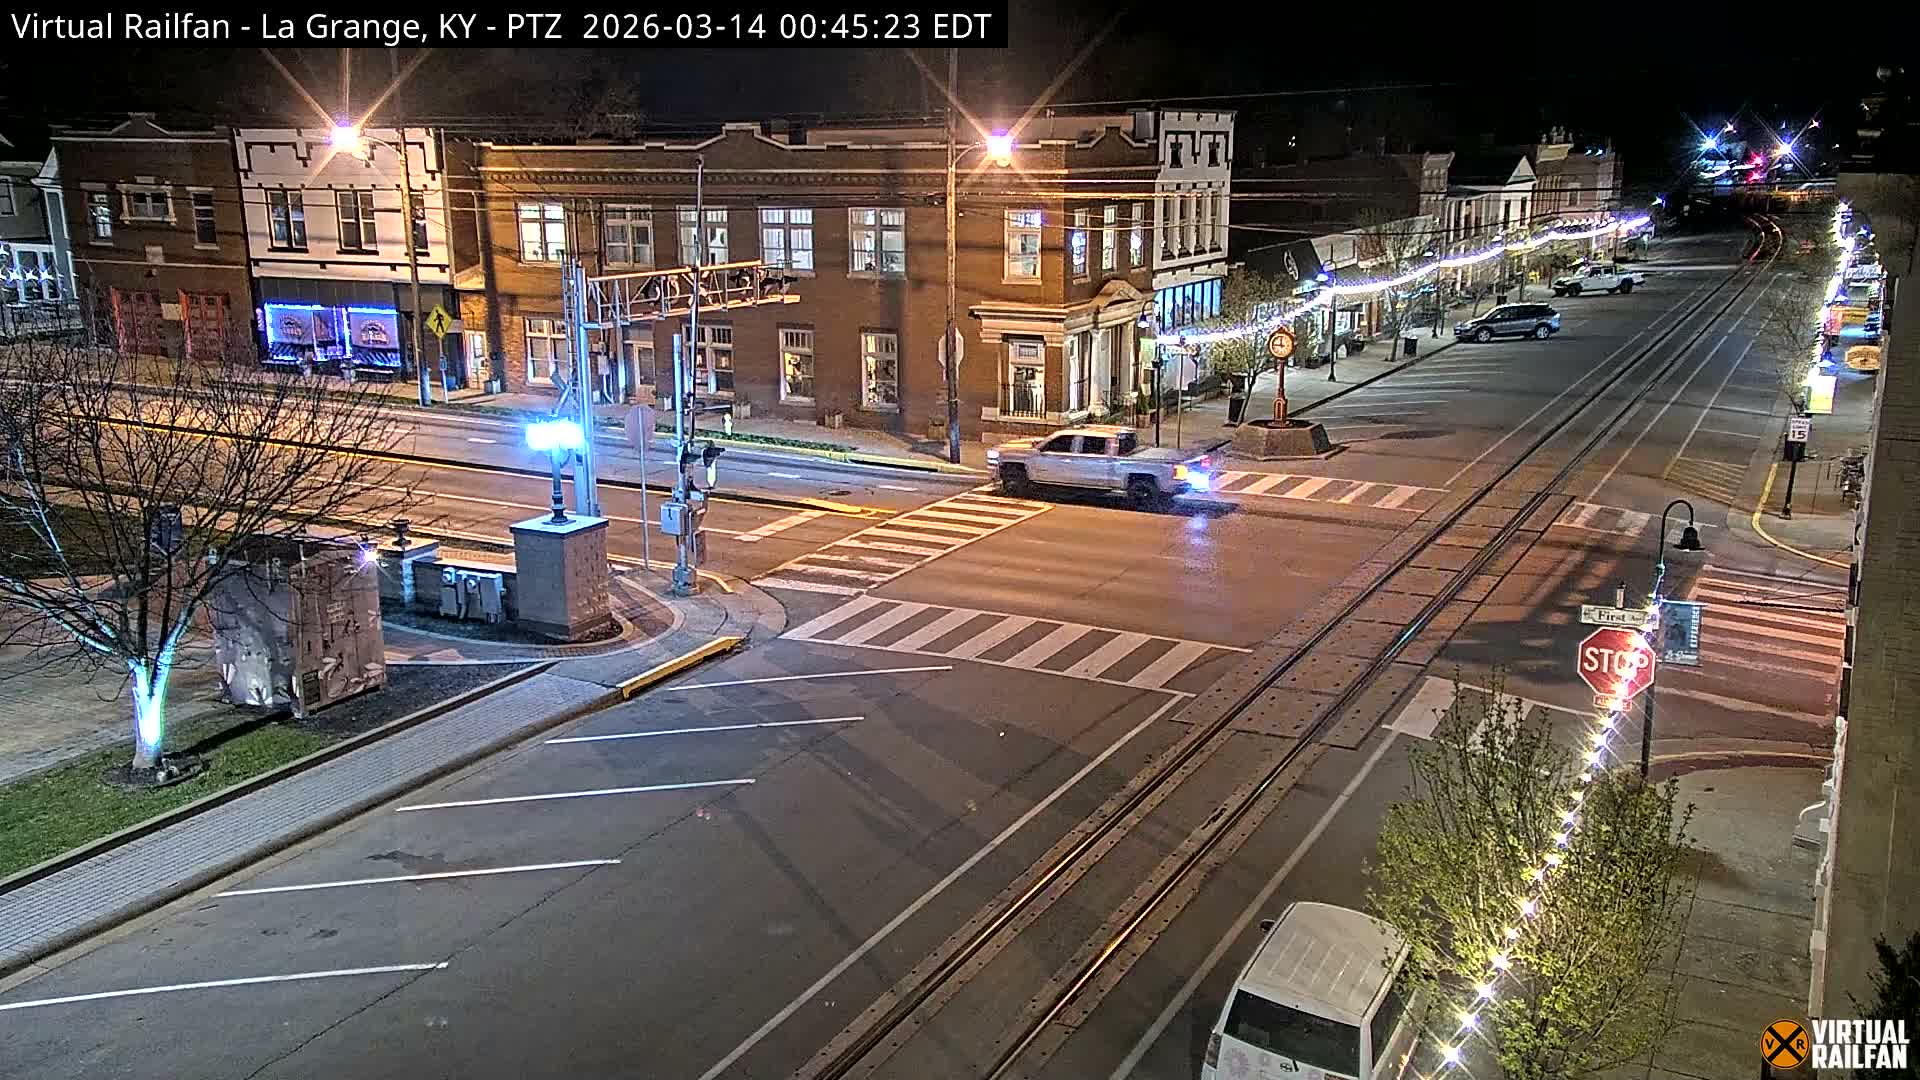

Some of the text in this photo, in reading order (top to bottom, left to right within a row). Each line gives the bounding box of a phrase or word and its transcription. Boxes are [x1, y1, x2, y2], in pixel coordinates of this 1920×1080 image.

[1792, 430, 1806, 439] 15
[1598, 610, 1626, 622] First
[1584, 647, 1649, 676] STOP
